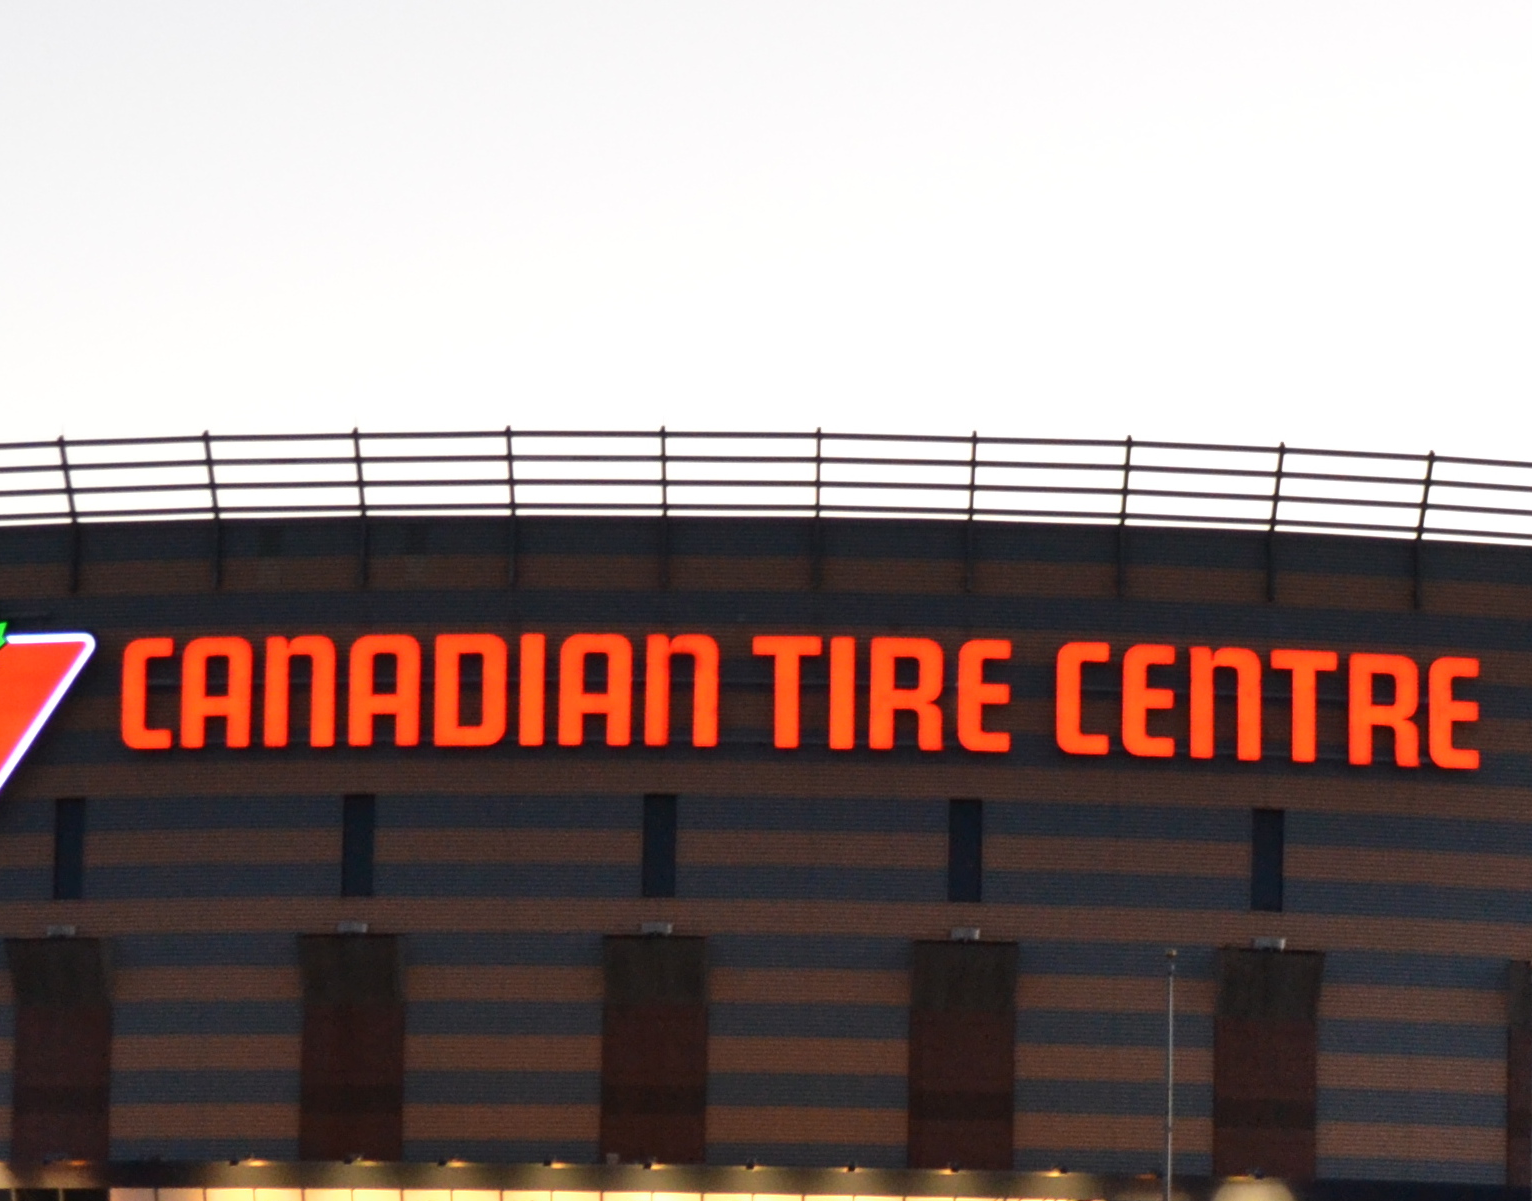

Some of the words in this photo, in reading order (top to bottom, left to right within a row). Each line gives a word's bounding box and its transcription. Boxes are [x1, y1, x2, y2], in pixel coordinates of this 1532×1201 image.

[122, 634, 719, 749] CANADIAN
[753, 636, 1011, 752] TIRE
[1056, 642, 1479, 769] CENTRE
